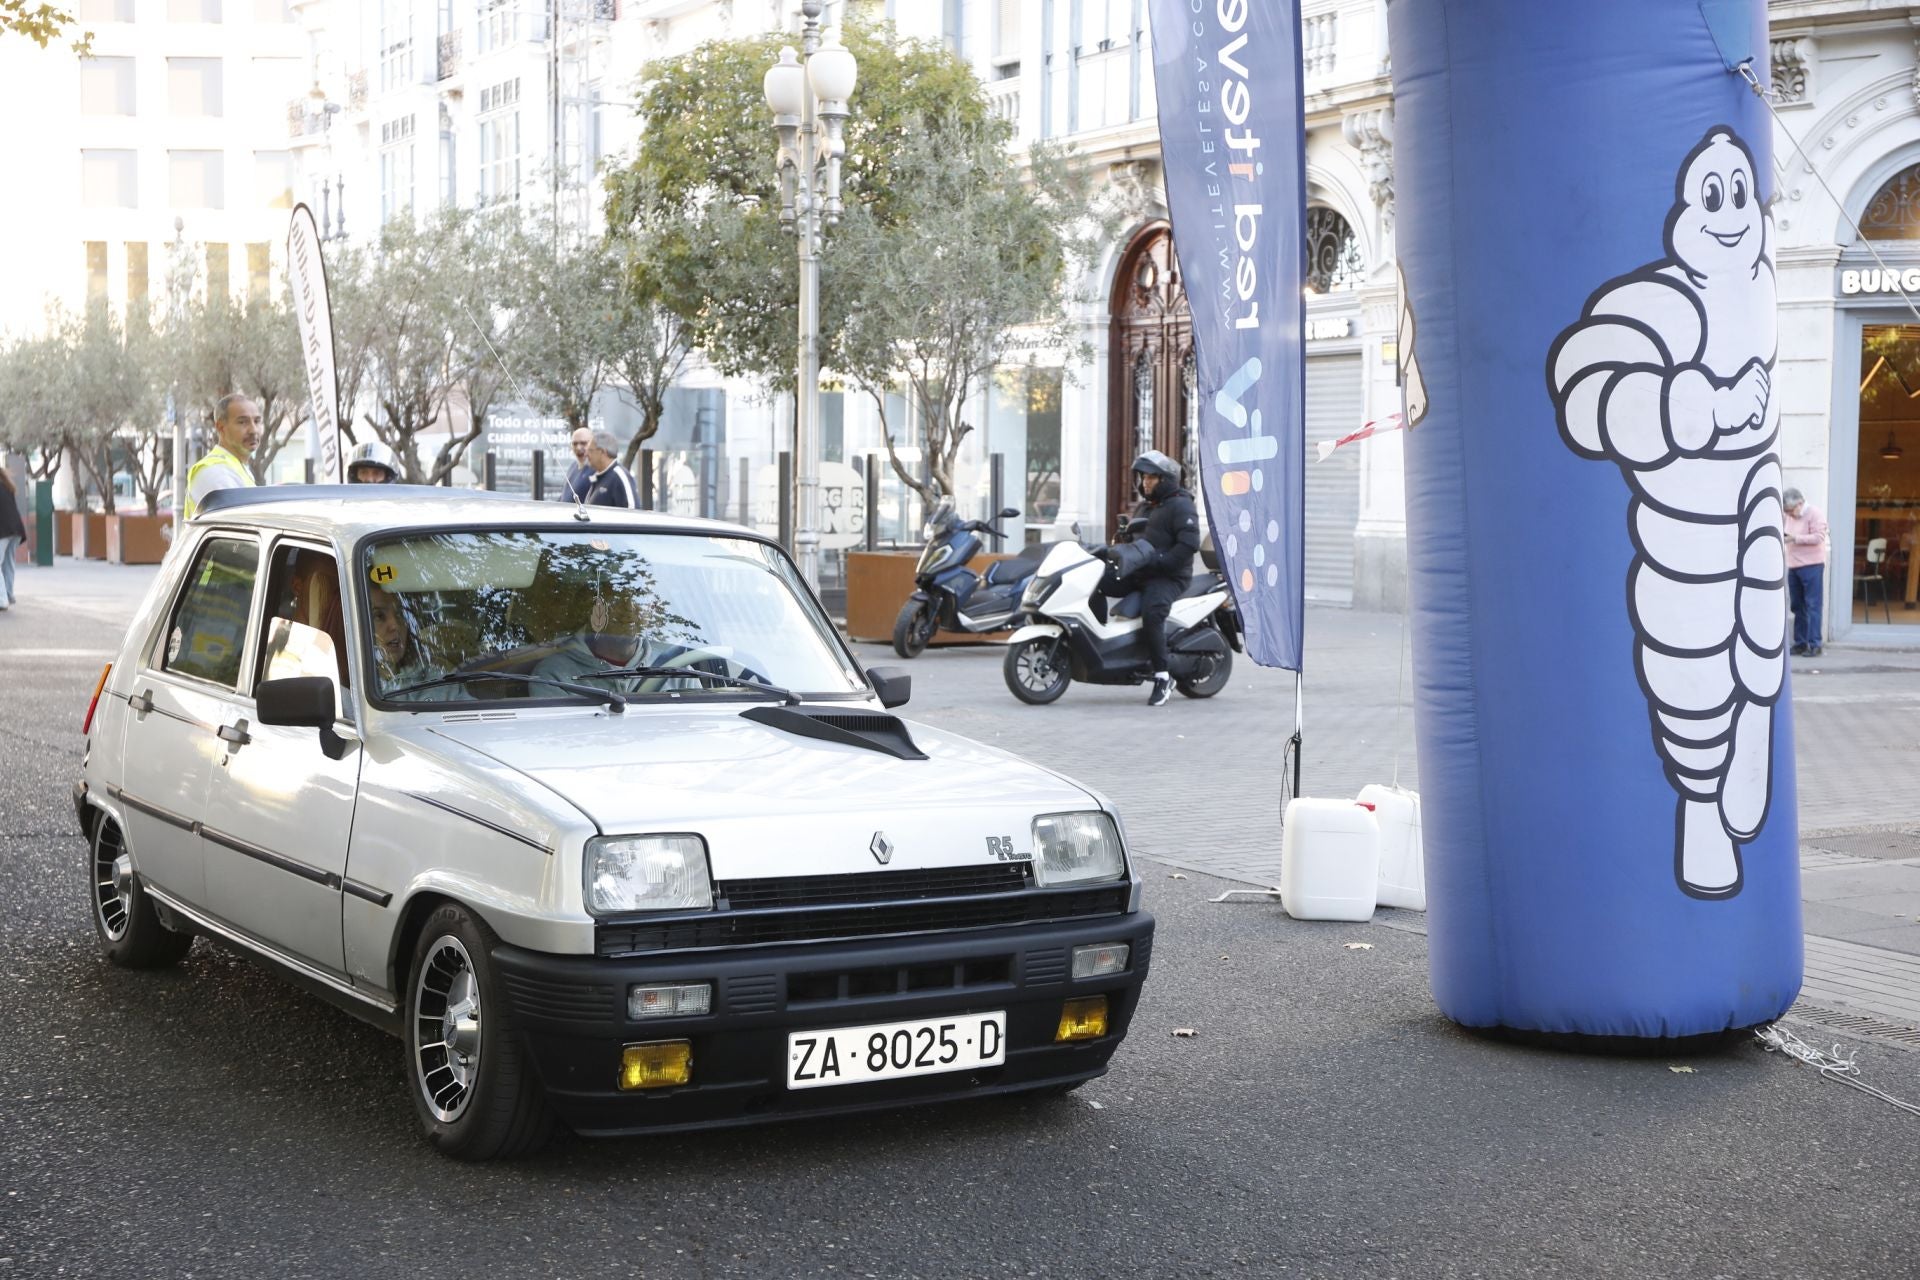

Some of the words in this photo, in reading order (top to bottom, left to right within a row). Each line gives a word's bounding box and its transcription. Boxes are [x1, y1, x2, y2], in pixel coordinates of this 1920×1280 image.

[1842, 268, 1920, 294] BURG
[487, 414, 521, 429] Todo
[487, 430, 539, 444] cuando
[377, 566, 393, 581] H
[986, 836, 1013, 855] R5
